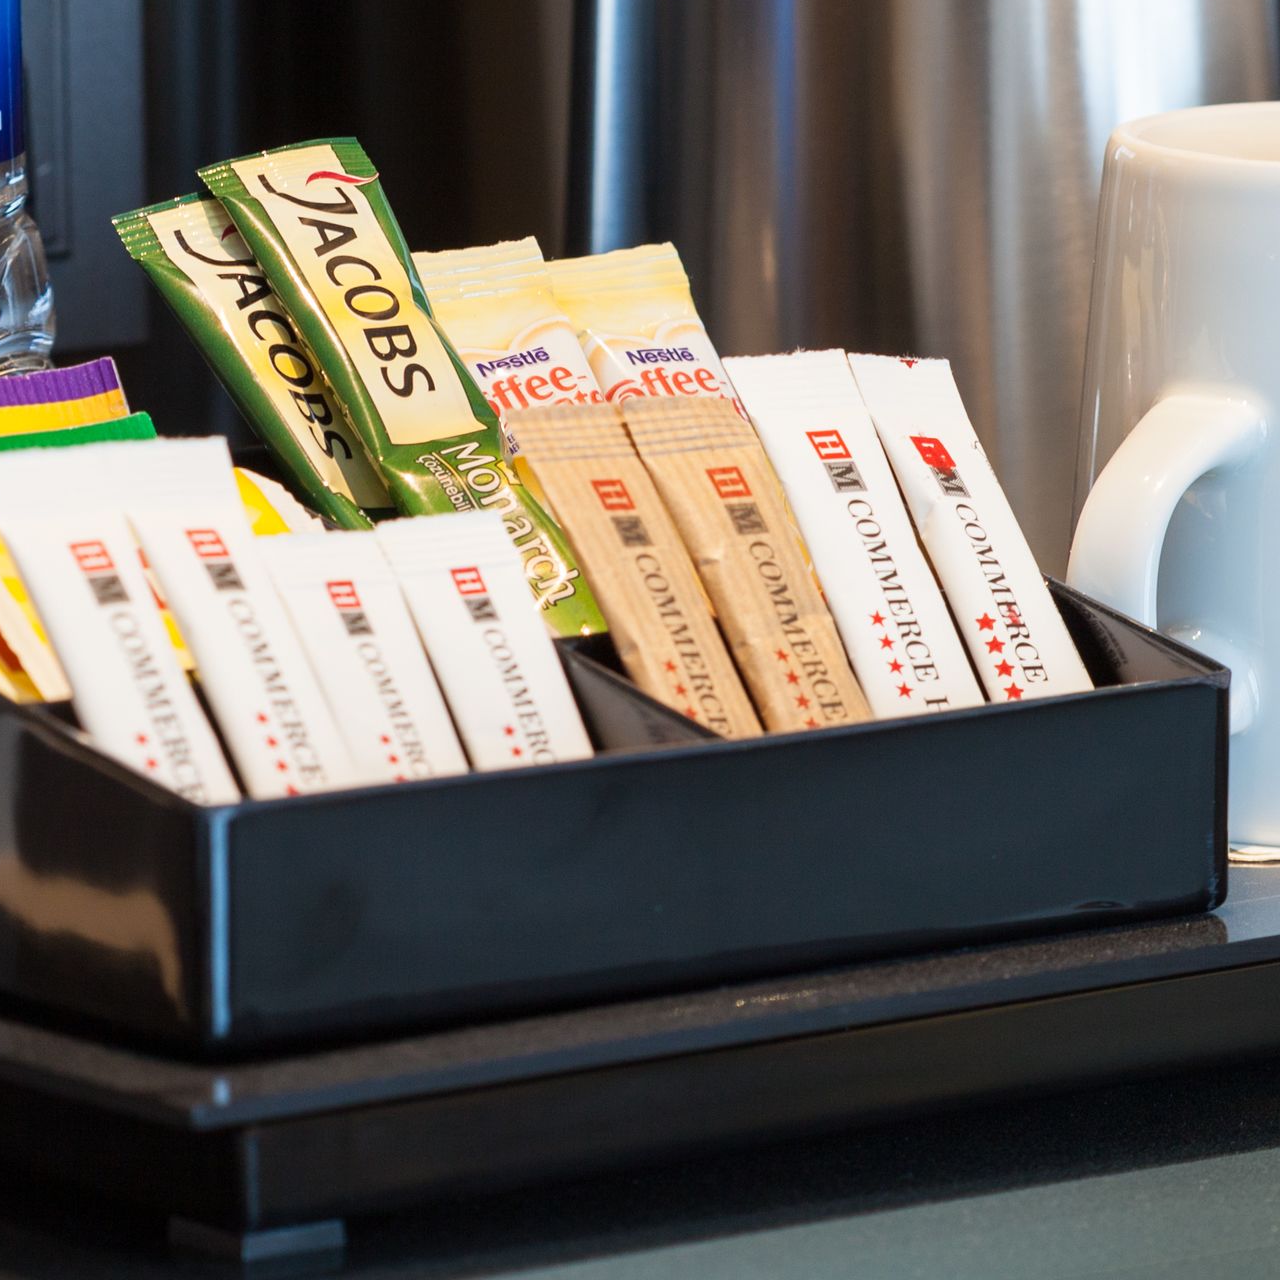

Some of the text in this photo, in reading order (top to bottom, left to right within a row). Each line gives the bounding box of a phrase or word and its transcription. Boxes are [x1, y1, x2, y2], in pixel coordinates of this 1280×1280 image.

[174, 229, 353, 460] JACOBS
[258, 173, 436, 399] JACOBS
[487, 366, 588, 417] ffee-
[416, 454, 473, 512] Çözünebil
[440, 442, 580, 607] Monarch
[748, 541, 847, 721] COMMERCE
[847, 498, 940, 684] COMMERCE
[955, 503, 1049, 684] COMMERCE
[358, 641, 432, 777] COMMERC
[483, 627, 556, 765] COMMERC
